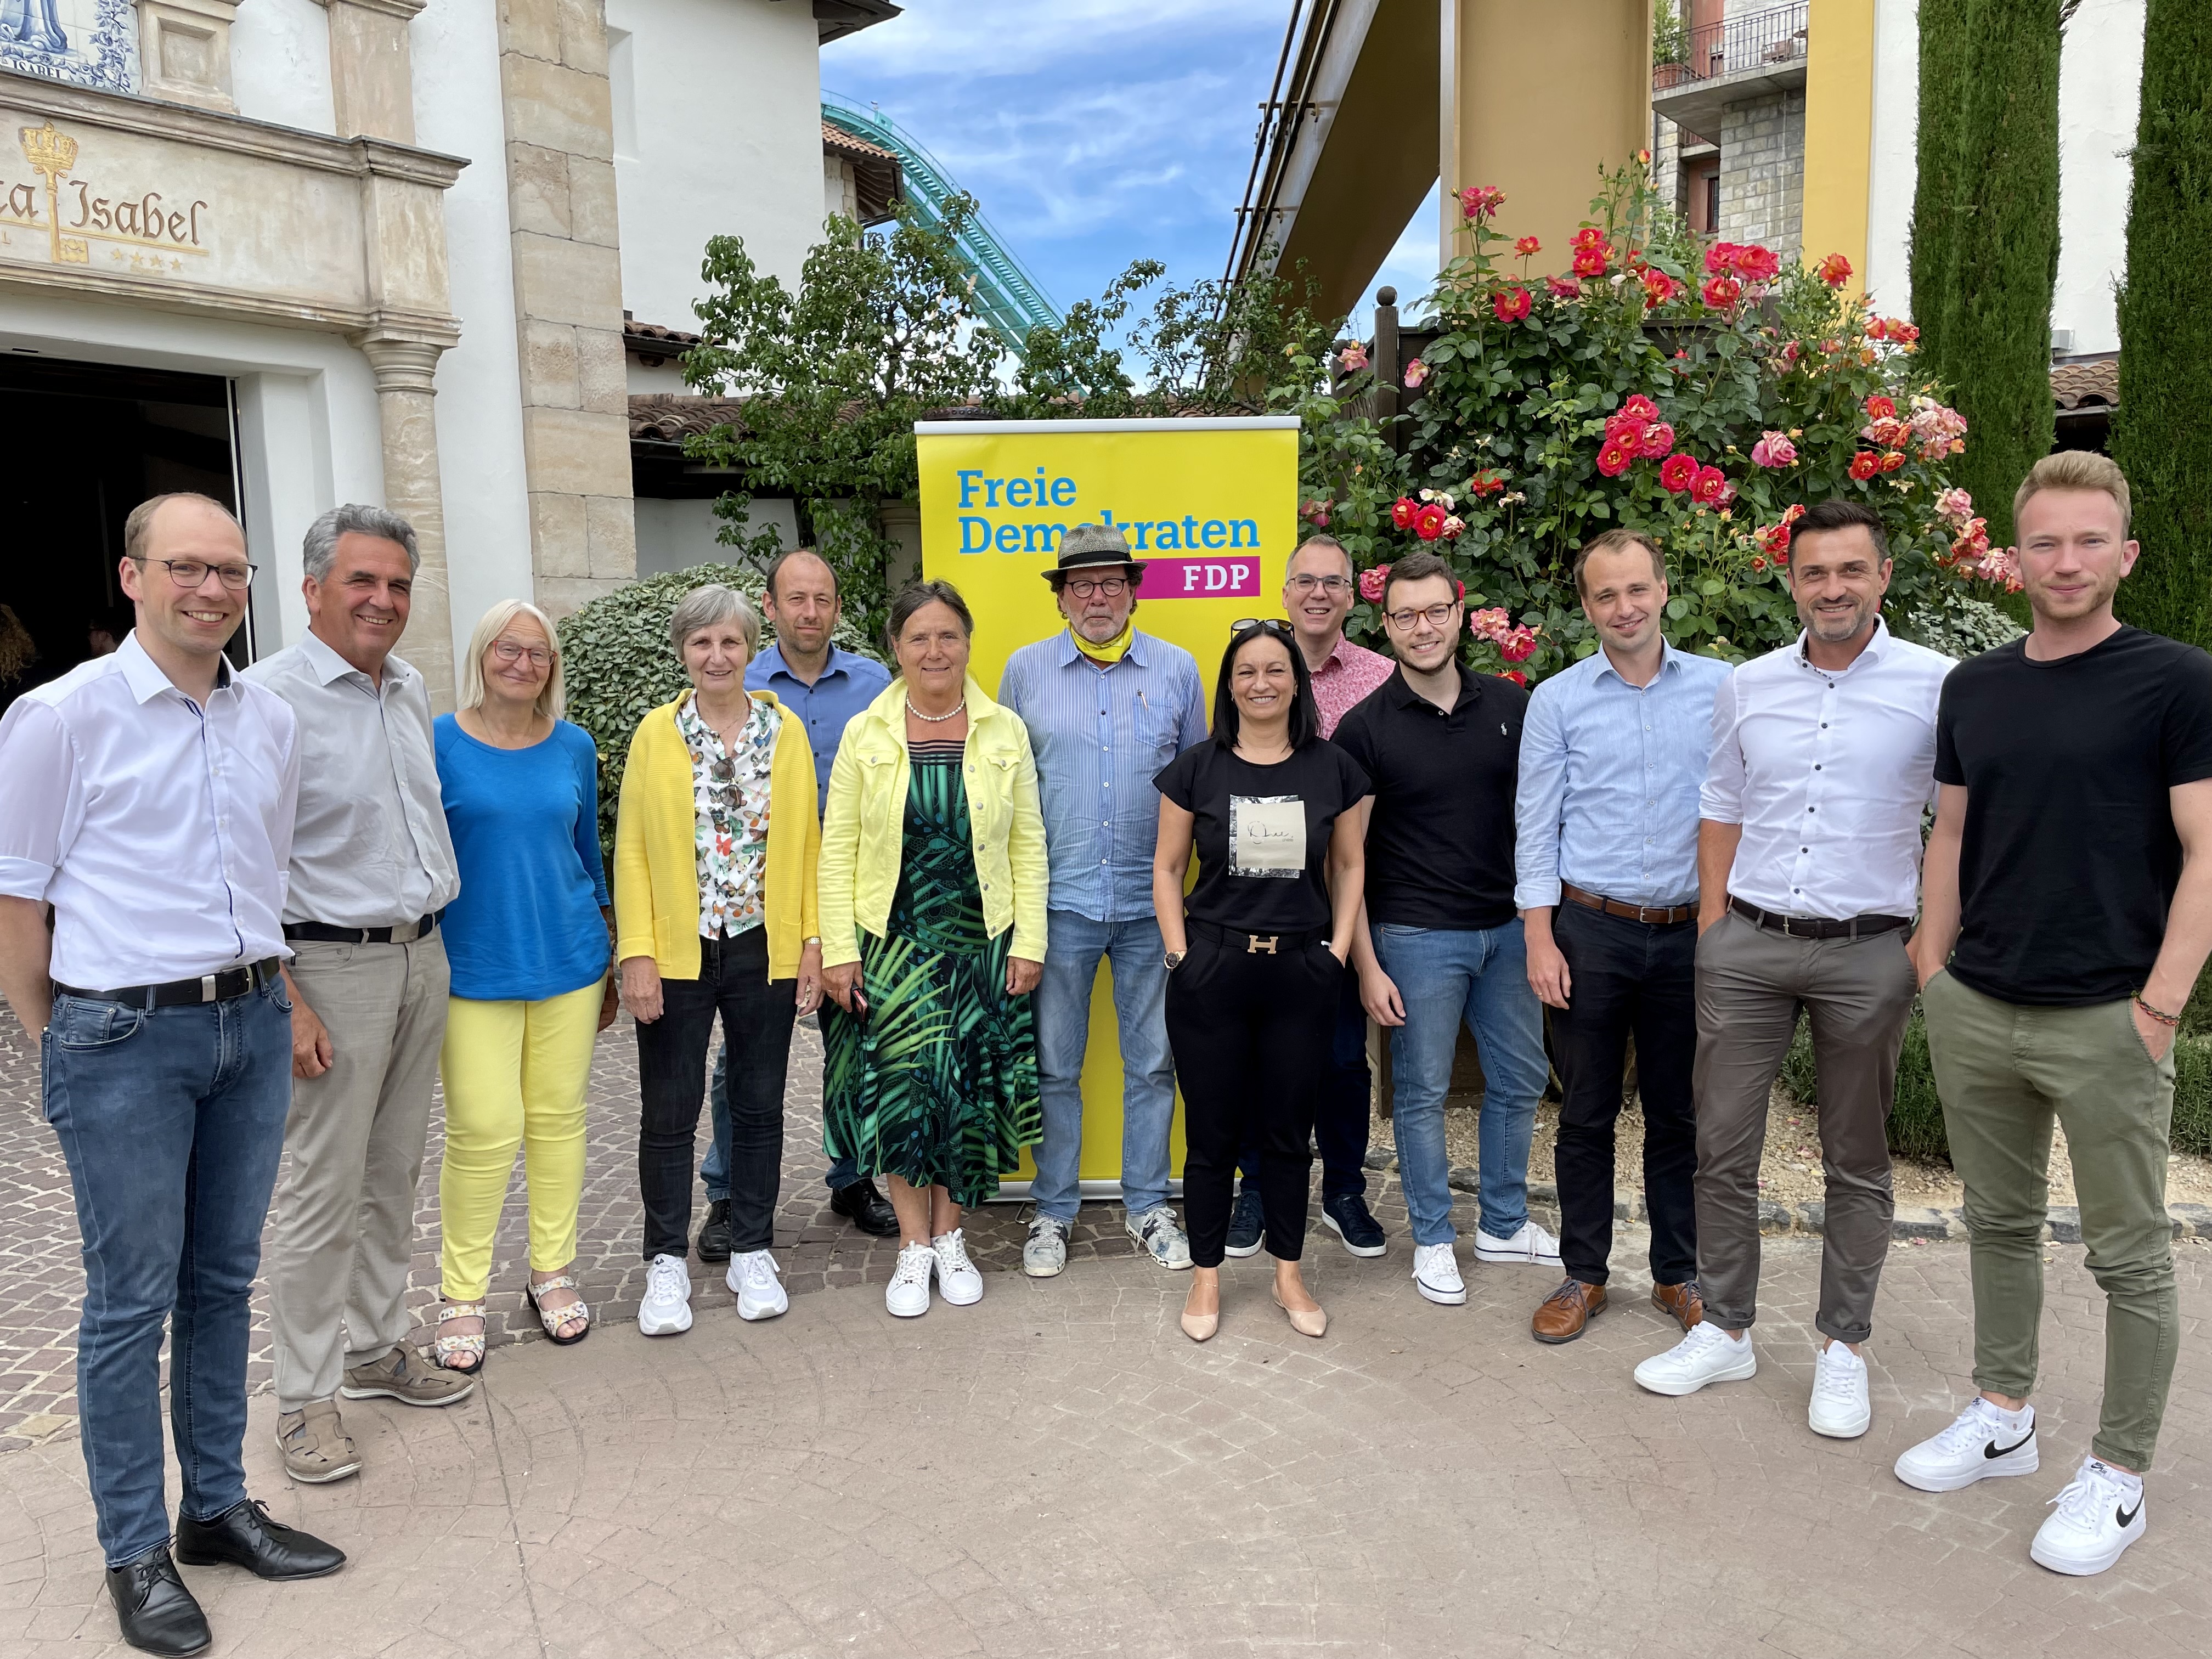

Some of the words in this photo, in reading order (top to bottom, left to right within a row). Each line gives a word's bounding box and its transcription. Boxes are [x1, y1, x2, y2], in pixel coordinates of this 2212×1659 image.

[0, 180, 38, 218] a
[69, 180, 208, 245] Isabel
[957, 466, 1077, 508] Freie
[958, 510, 1261, 554] Demraten
[1183, 565, 1249, 590] FDP
